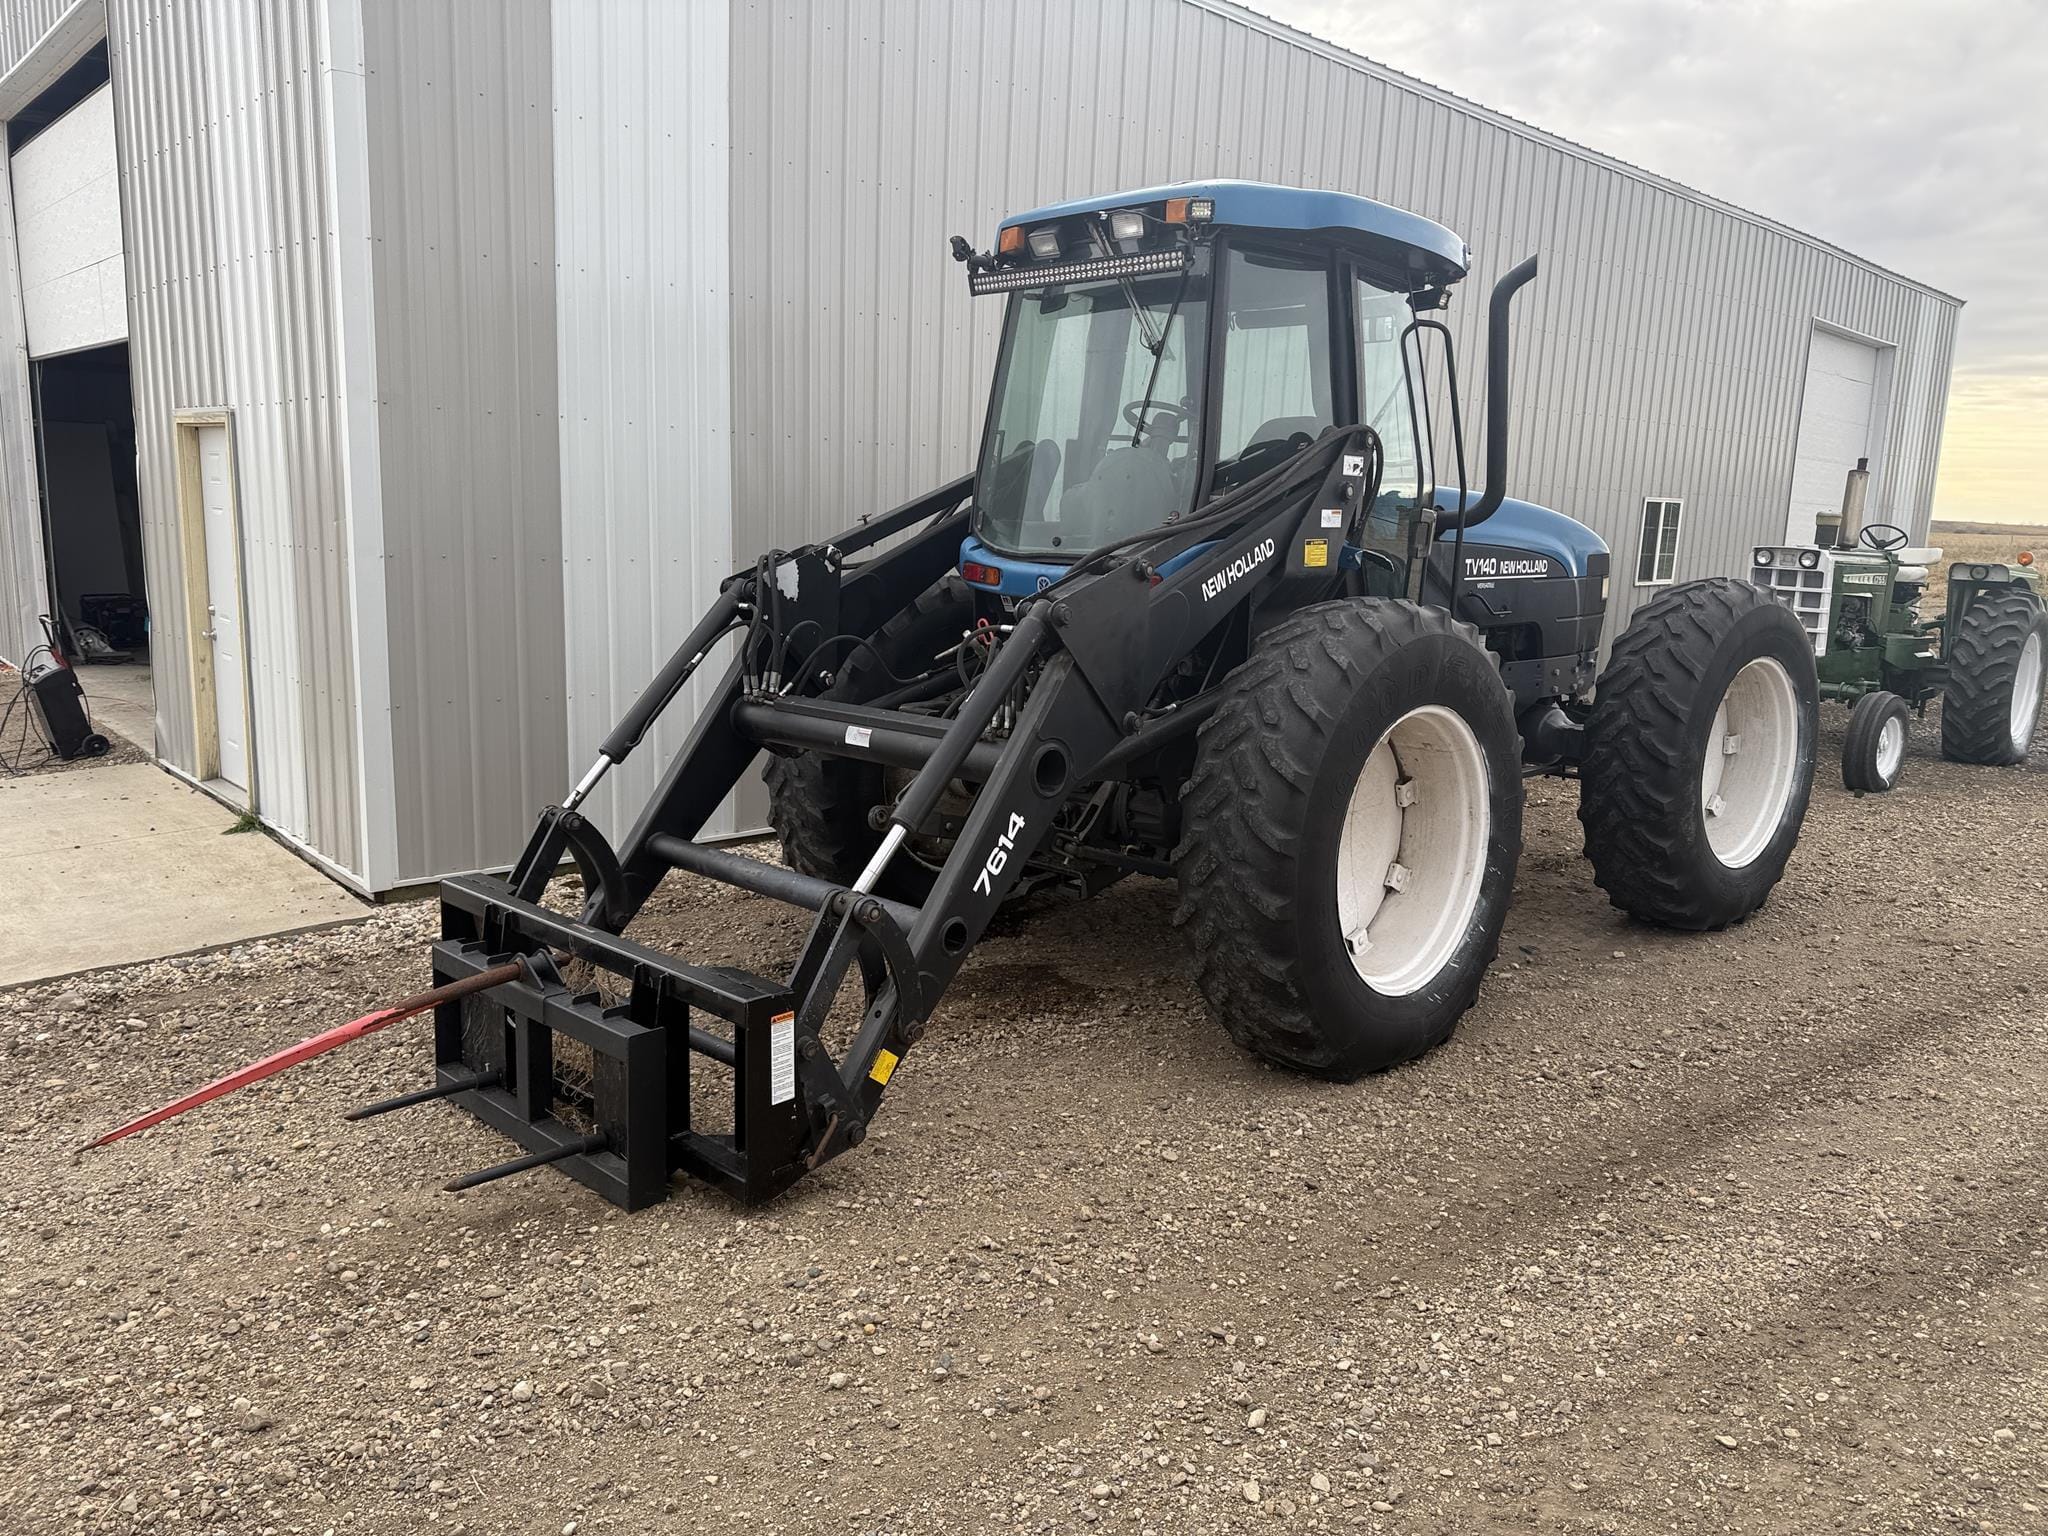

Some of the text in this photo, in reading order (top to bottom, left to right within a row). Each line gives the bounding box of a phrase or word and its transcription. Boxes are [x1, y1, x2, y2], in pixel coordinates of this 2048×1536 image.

[1201, 569, 1227, 602] NEW
[1226, 538, 1275, 585] HOLLAND
[1465, 557, 1548, 576] TV140 NEW HOLLAND
[972, 811, 1026, 897] 7614
